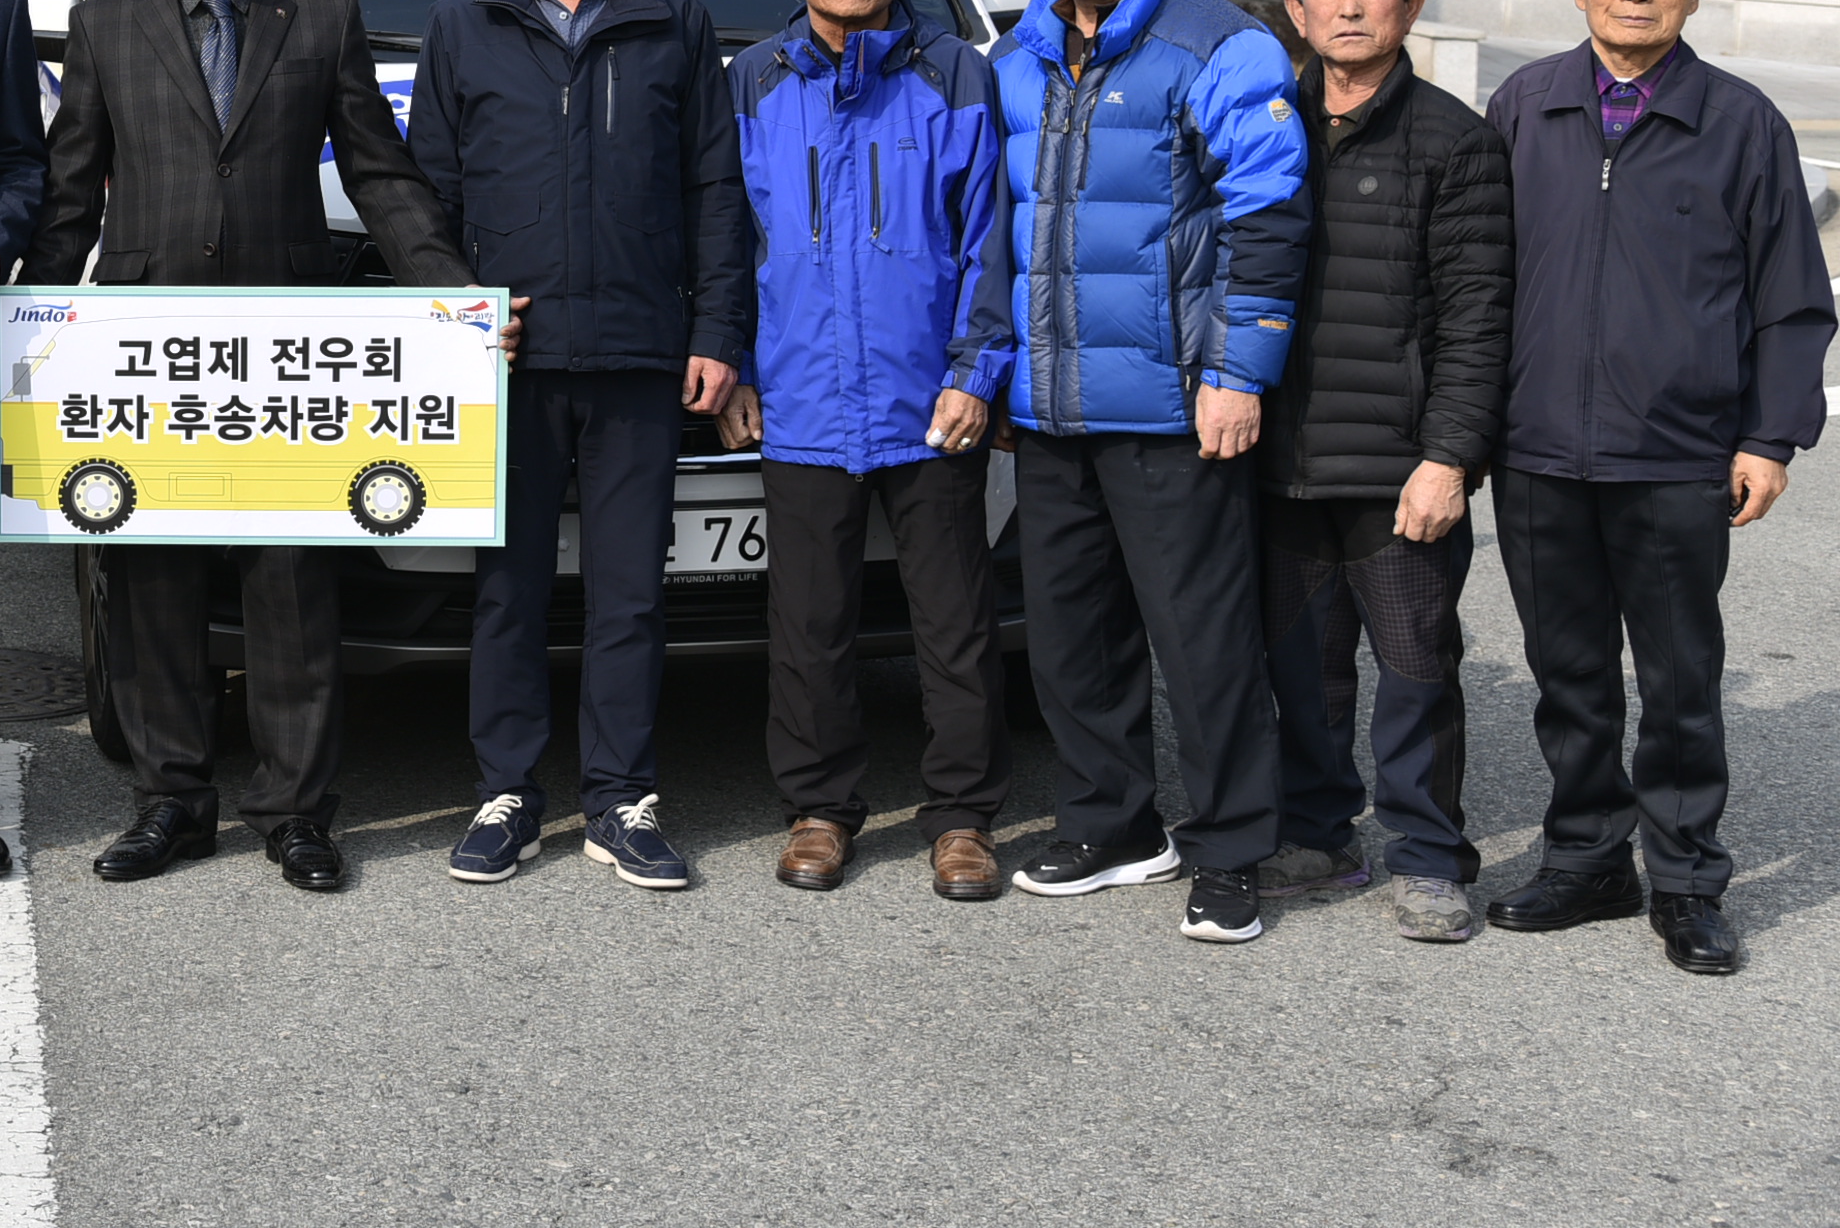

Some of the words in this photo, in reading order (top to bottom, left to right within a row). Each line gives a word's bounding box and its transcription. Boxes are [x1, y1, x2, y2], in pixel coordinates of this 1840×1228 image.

[8, 307, 65, 323] Jindo
[114, 336, 249, 382] 고엽제
[270, 336, 402, 382] 전우회
[60, 394, 150, 440] 환자
[167, 394, 348, 441] 후송차량
[370, 394, 455, 441] 지원
[673, 575, 715, 584] HYUNDAI
[717, 574, 736, 582] FOR
[738, 573, 758, 581] LIFE
